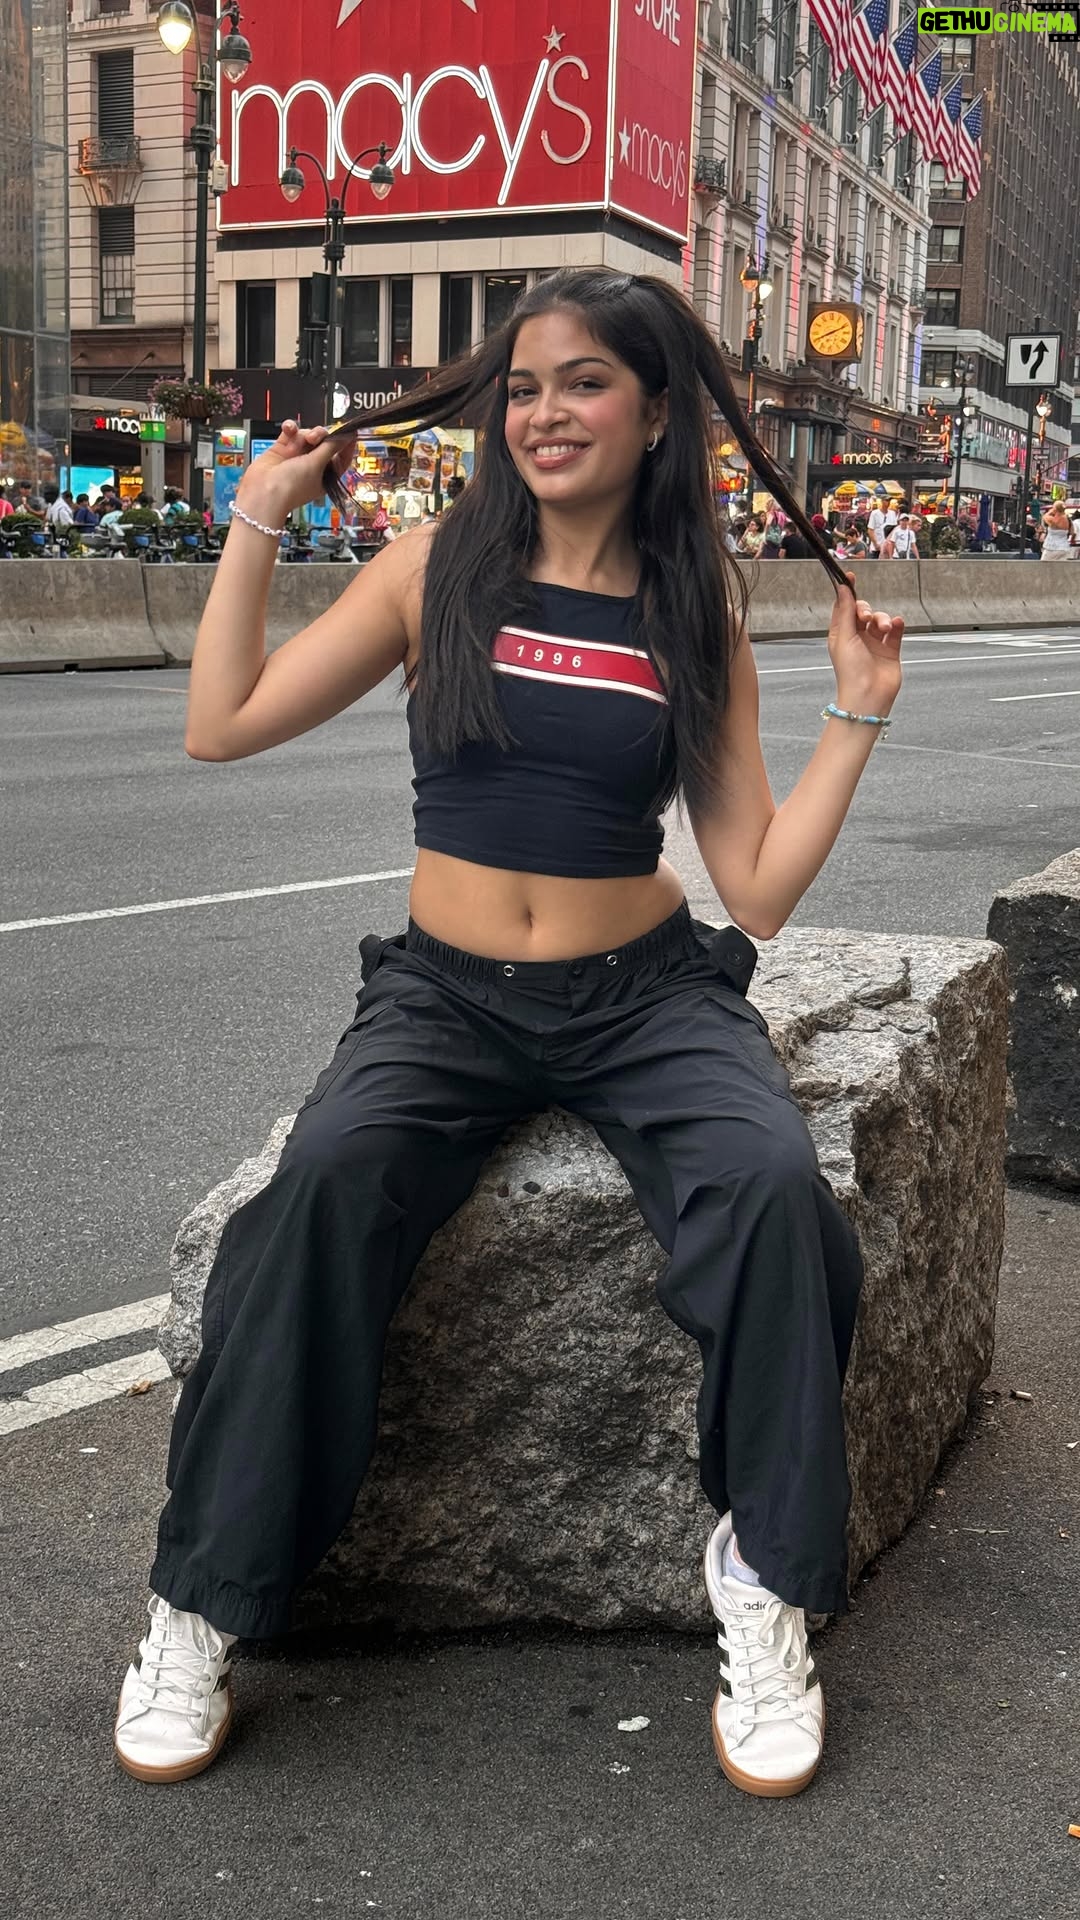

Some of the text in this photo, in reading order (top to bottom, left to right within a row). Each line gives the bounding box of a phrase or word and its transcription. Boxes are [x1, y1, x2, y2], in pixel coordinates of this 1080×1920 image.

[634, 0, 680, 47] ORE
[231, 25, 592, 205] macy's
[631, 122, 686, 206] macy's
[843, 450, 892, 467] macy's
[517, 645, 582, 668] 1996
